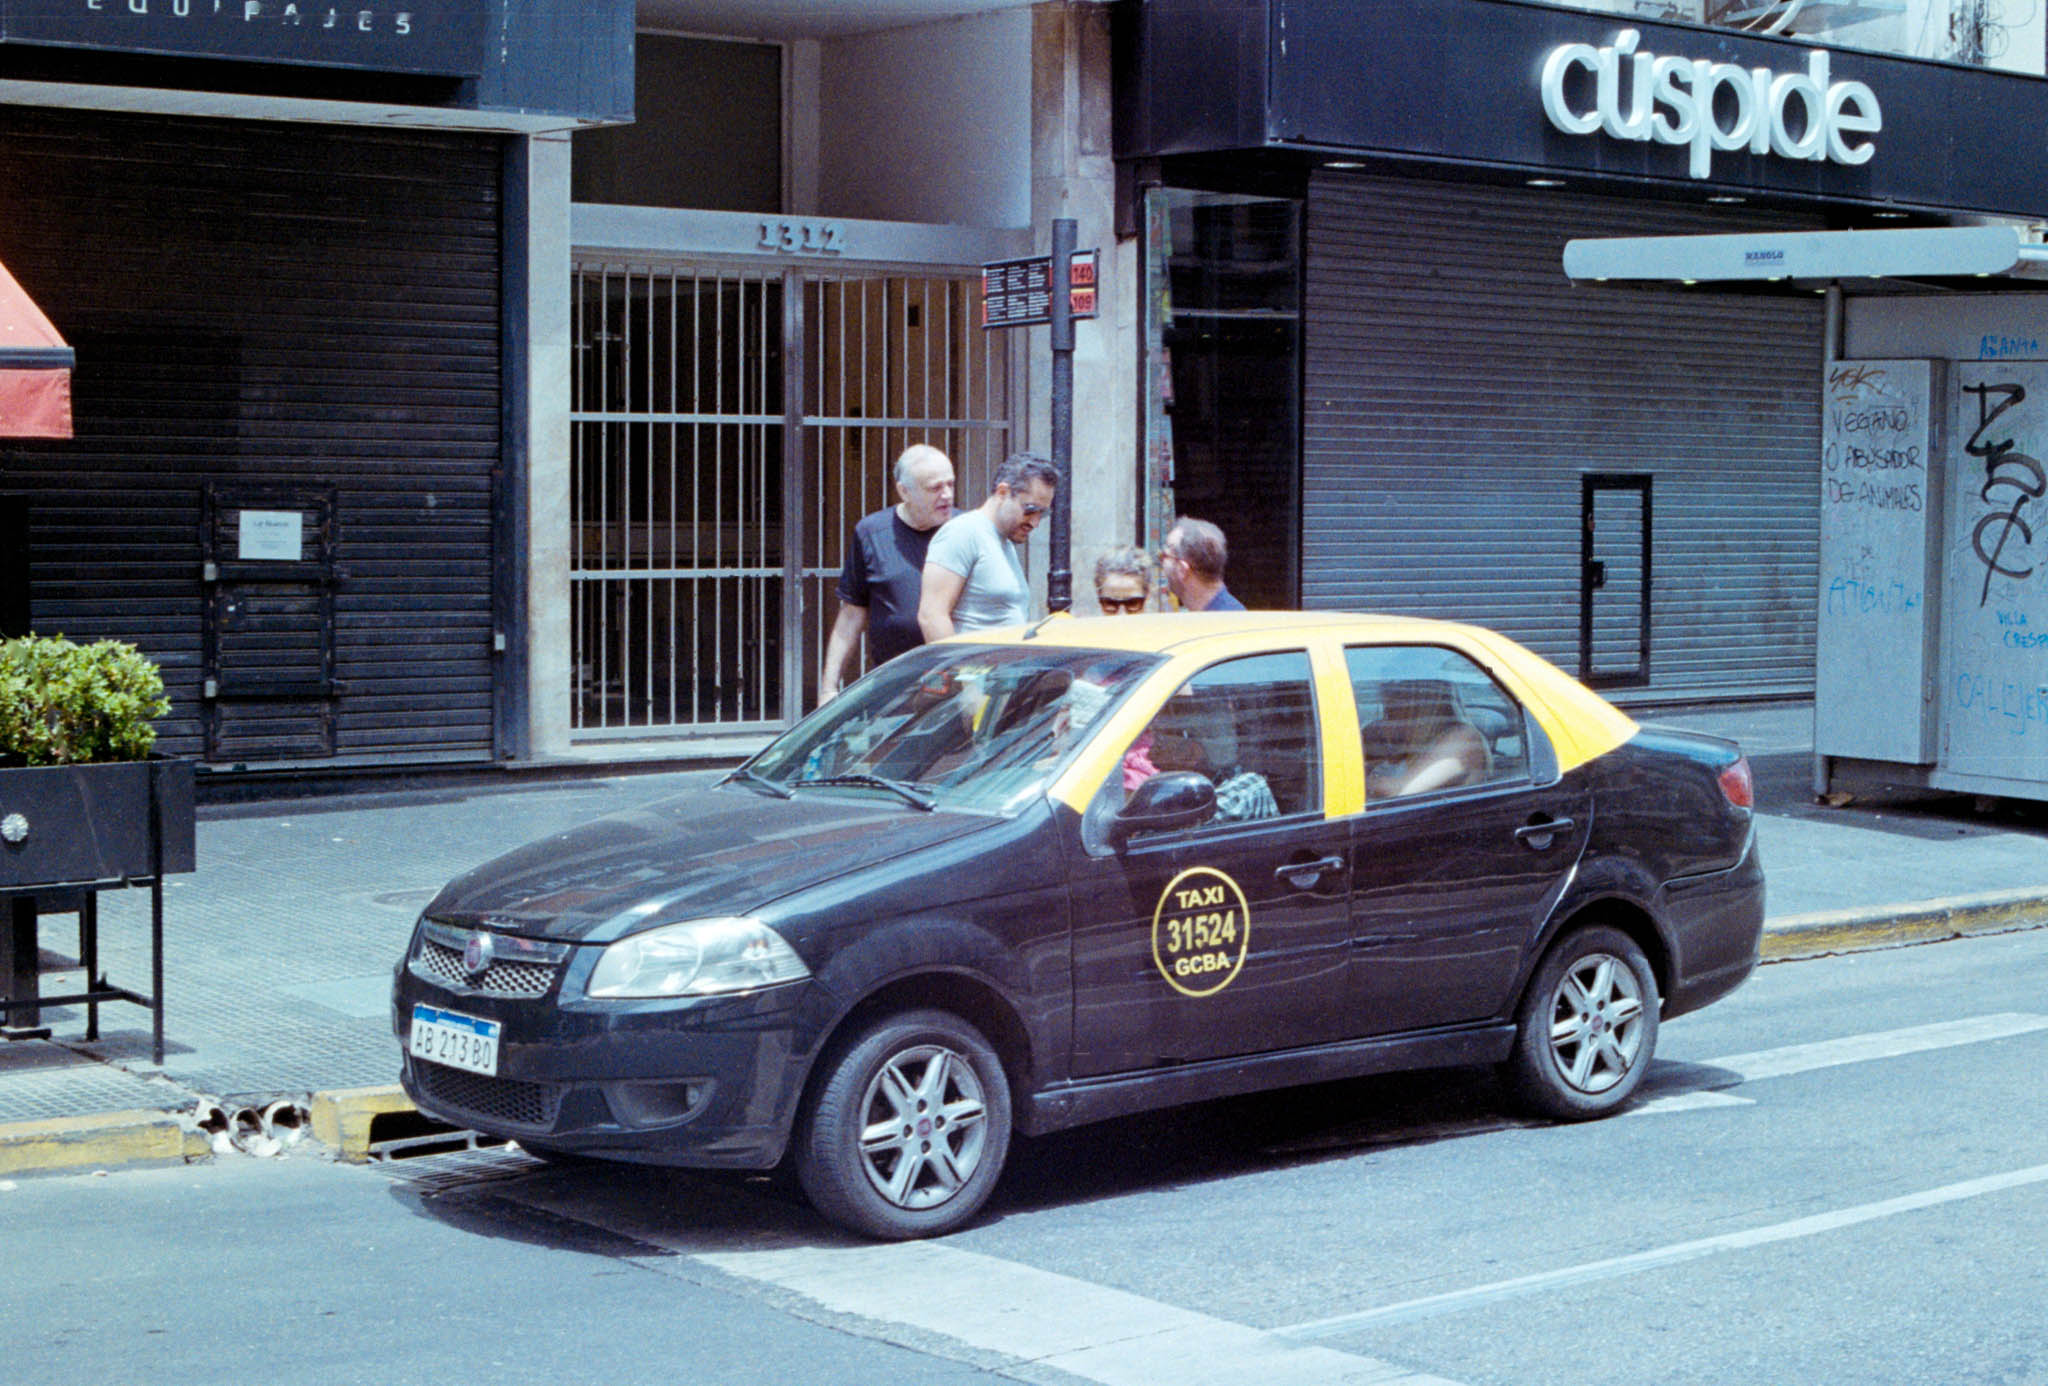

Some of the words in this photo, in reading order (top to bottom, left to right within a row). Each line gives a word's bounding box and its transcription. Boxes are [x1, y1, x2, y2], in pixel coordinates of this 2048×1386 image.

[1541, 28, 1882, 179] cúspide
[758, 222, 843, 253] 1312
[1073, 265, 1093, 281] 140
[1073, 294, 1092, 309] 109
[1175, 886, 1225, 909] TAXI
[1167, 910, 1237, 953] 31524
[1175, 951, 1231, 976] GCBA
[415, 1023, 434, 1054] AB
[438, 1031, 469, 1063] 213
